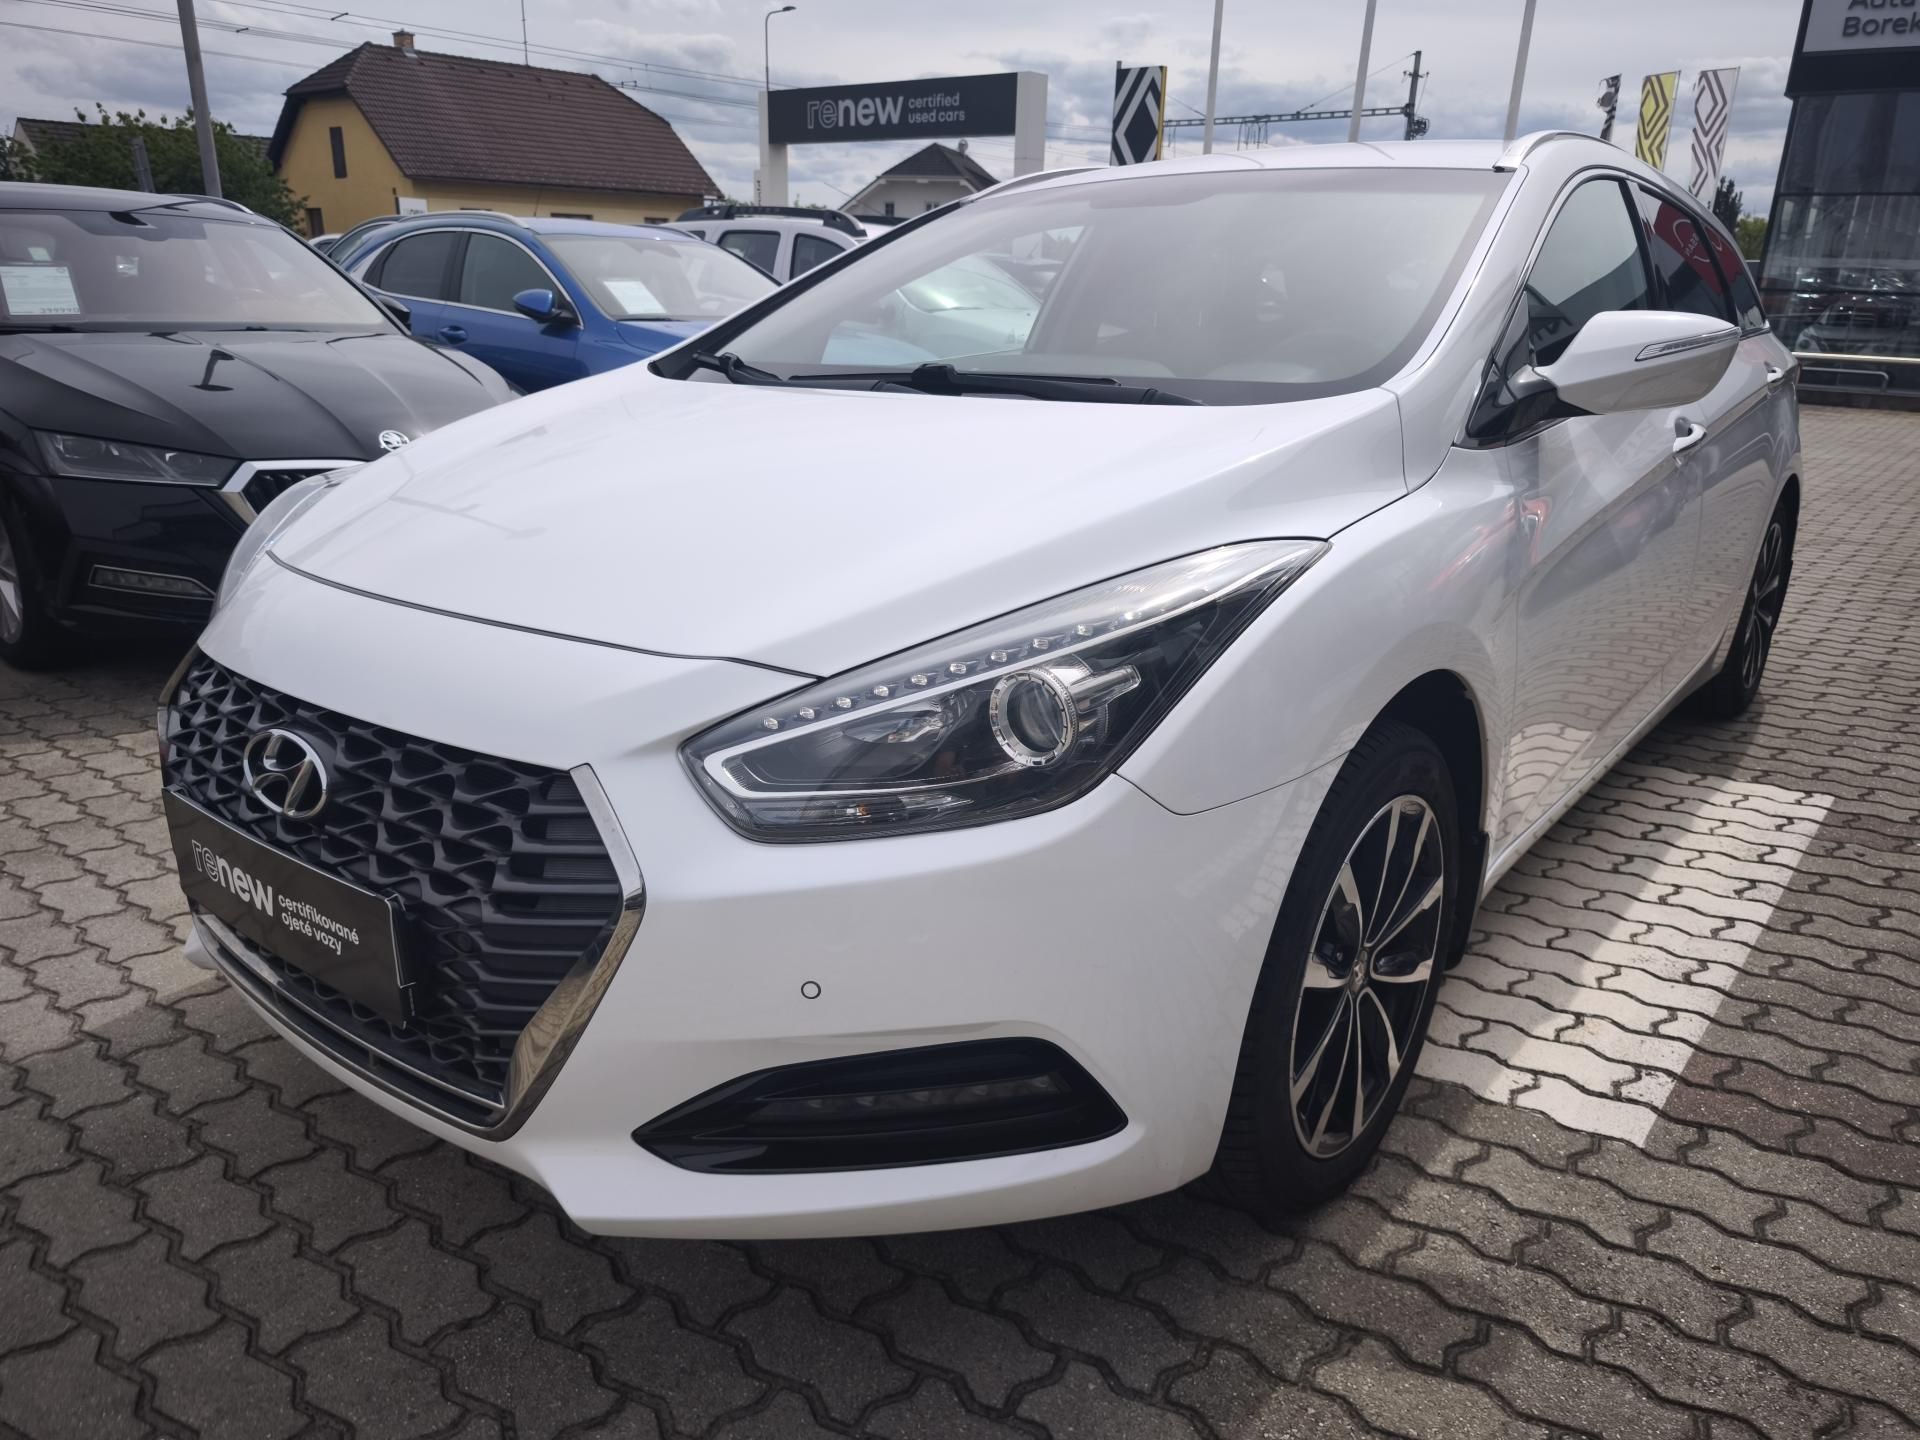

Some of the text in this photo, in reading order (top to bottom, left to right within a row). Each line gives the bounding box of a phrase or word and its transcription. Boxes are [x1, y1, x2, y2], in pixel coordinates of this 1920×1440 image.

[1842, 11, 1920, 37] Borek
[807, 96, 904, 129] renew
[908, 93, 960, 109] certified
[908, 109, 965, 123] used cars
[192, 840, 274, 917] renew
[278, 894, 359, 945] certifikované
[281, 911, 342, 955] ojeté vozy
